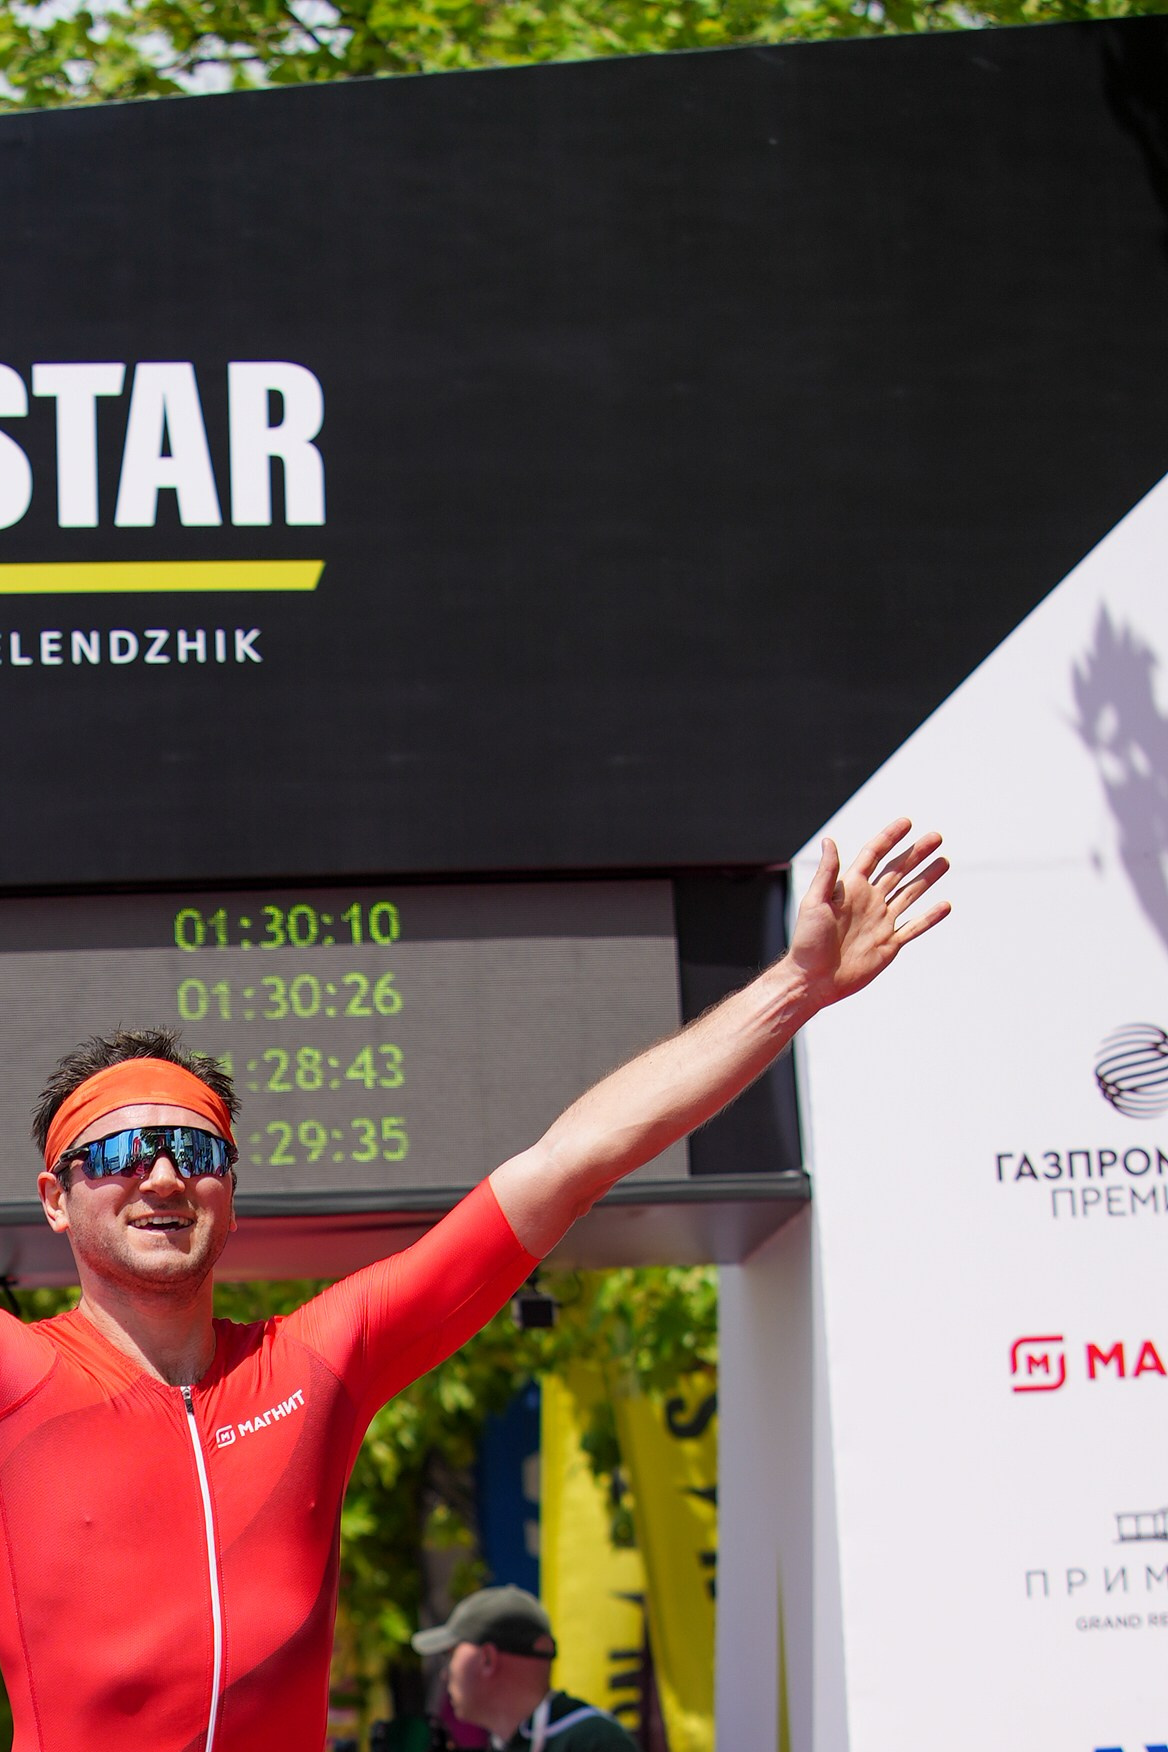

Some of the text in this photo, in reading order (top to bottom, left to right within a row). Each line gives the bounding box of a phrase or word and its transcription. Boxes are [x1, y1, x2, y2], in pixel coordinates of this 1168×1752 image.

[173, 901, 402, 952] 01:30:10
[177, 971, 403, 1021] 01:30:26
[190, 1043, 405, 1092] 1:28:43
[234, 1116, 410, 1166] :29:35
[1051, 1185, 1168, 1217] ПРЕМ
[237, 1389, 305, 1437] МАГНИТ
[1076, 1614, 1141, 1631] GRAND
